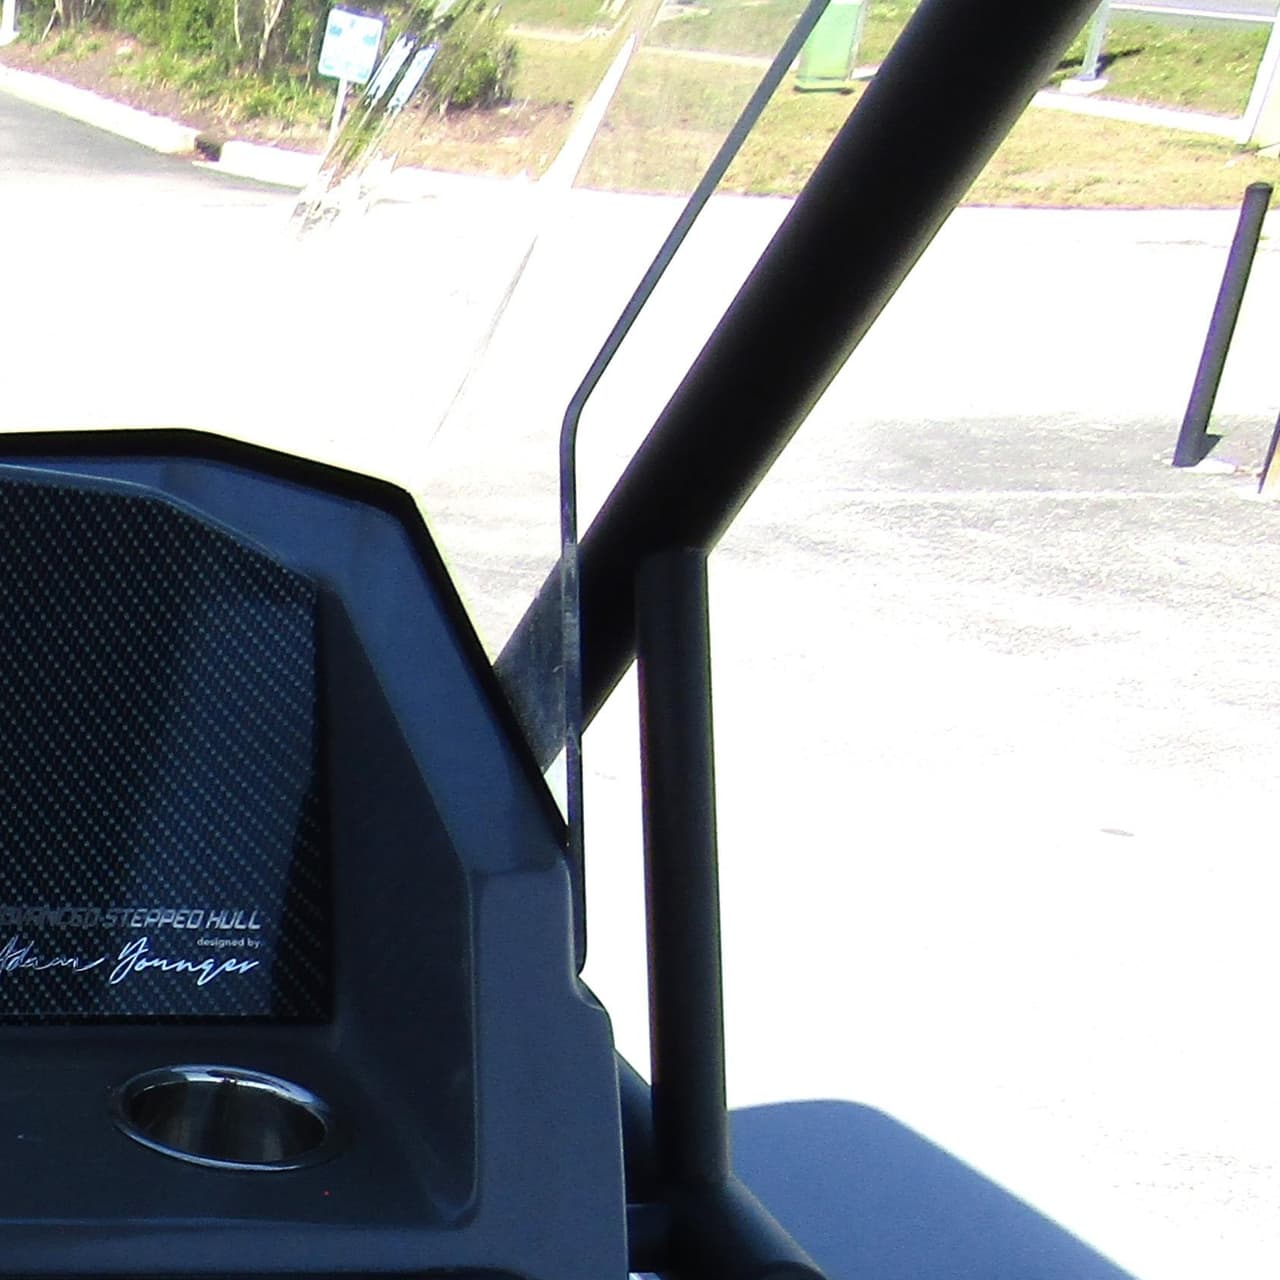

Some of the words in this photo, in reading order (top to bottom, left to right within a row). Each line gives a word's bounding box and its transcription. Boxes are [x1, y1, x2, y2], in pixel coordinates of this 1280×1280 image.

[102, 908, 203, 929] STEPPED
[206, 909, 262, 930] HULL
[196, 936, 245, 948] designed
[246, 937, 261, 948] by
